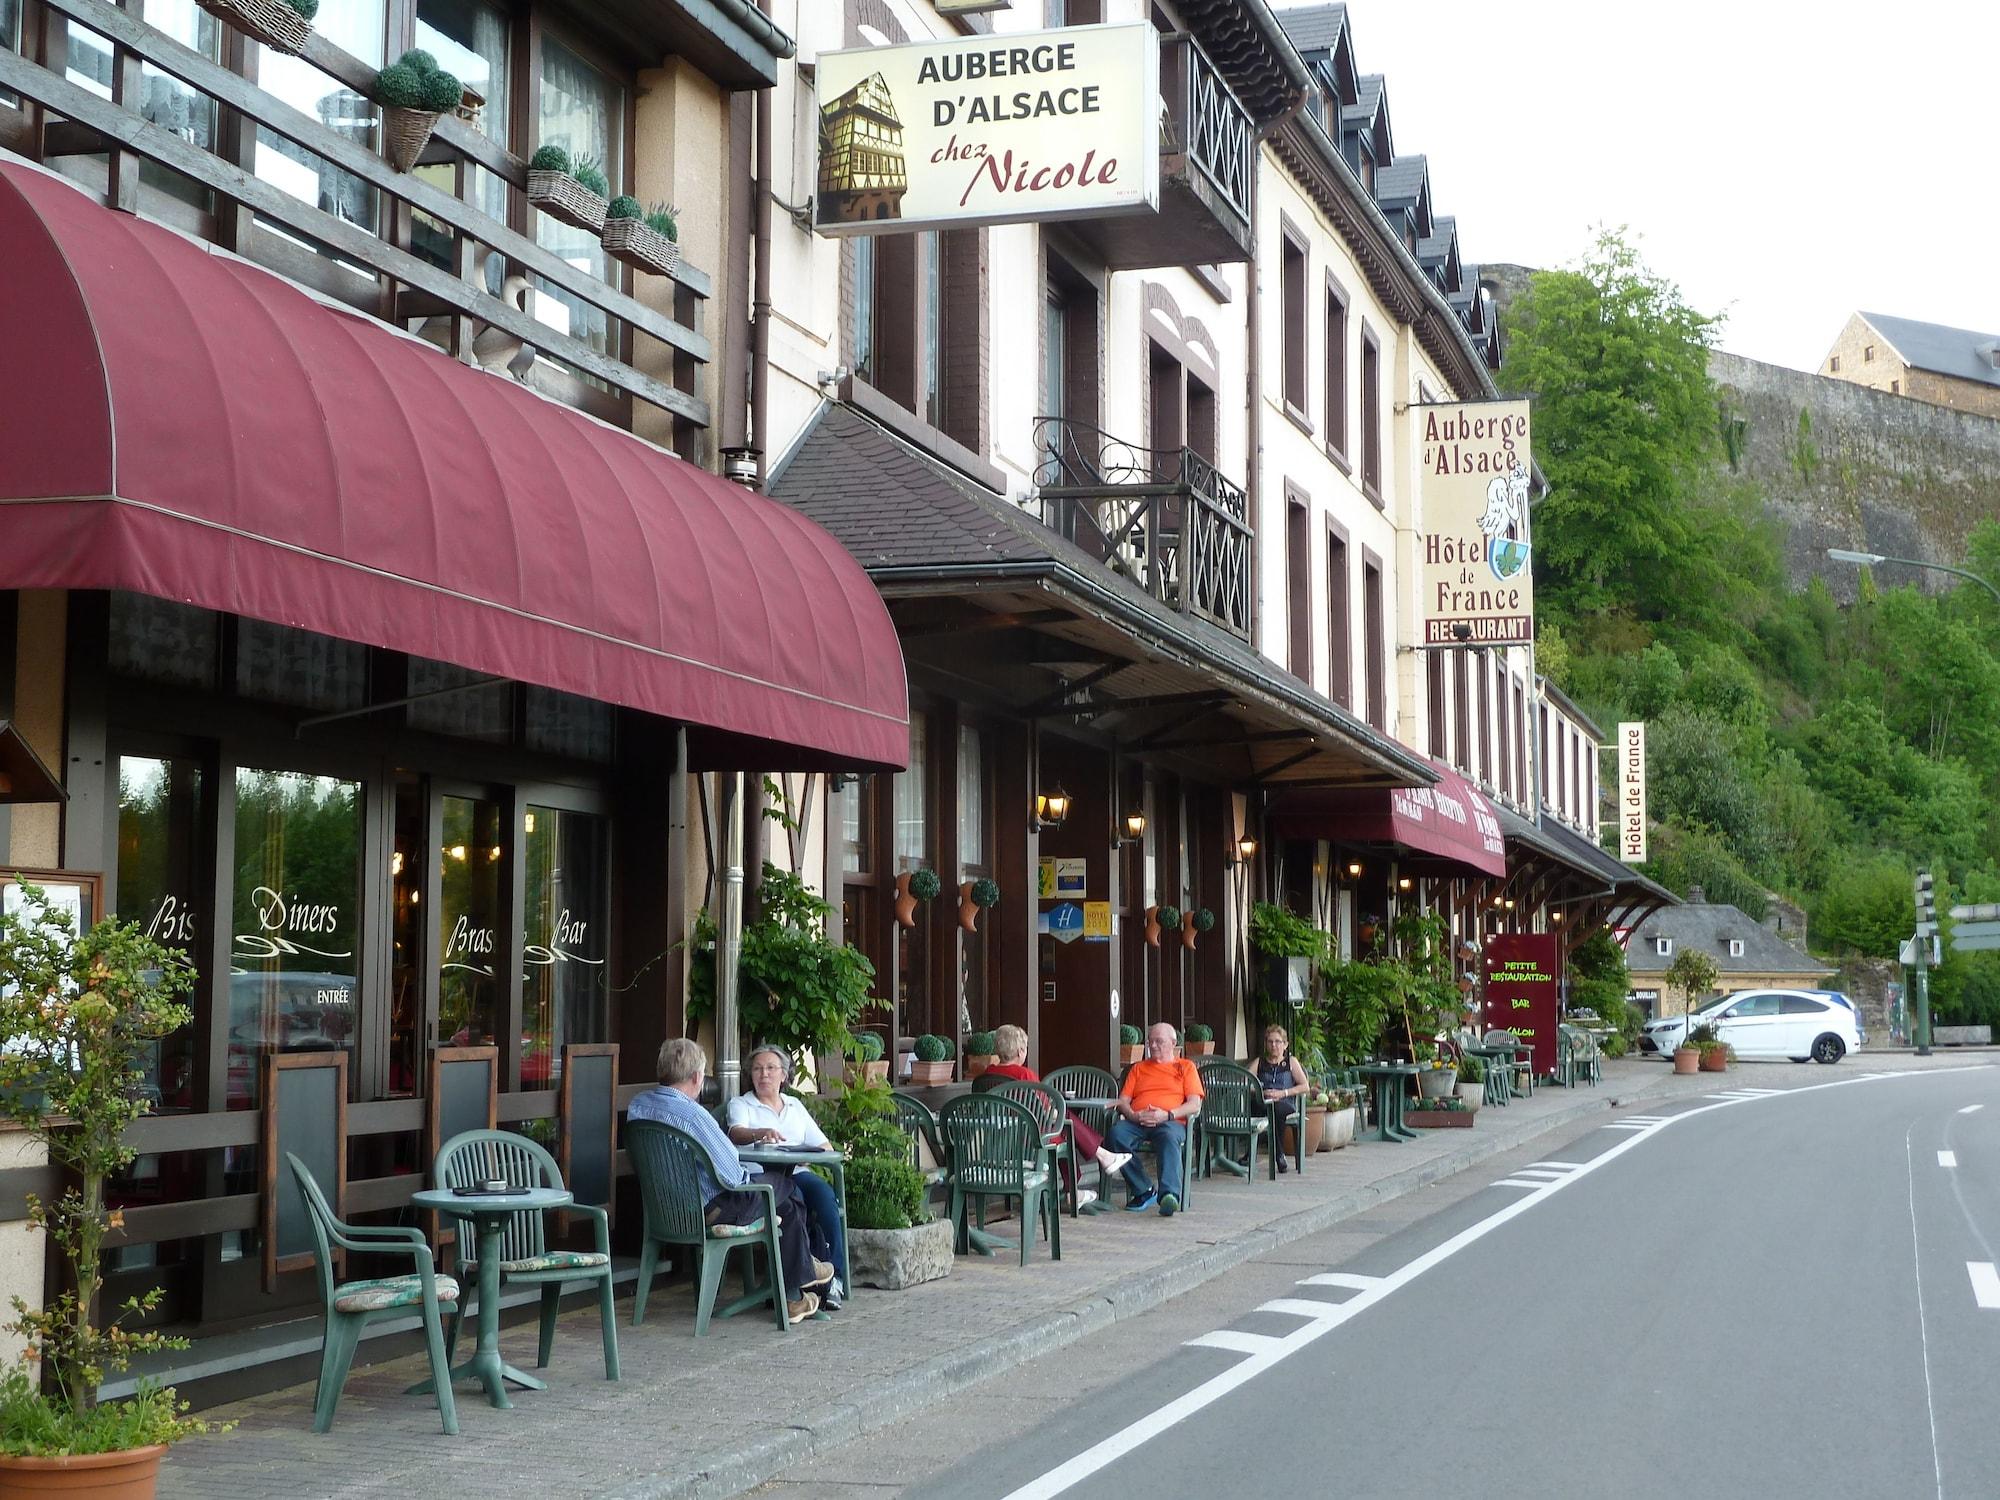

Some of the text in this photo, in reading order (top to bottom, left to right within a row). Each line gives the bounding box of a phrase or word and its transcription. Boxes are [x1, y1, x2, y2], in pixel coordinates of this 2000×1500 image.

[917, 42, 1076, 84] AUBERGE
[933, 86, 1100, 127] D'ALSACE
[930, 134, 988, 164] chez
[960, 149, 1118, 207] Nicole
[1424, 410, 1526, 450] Auberge
[1424, 444, 1517, 475] d'Alsace
[1426, 534, 1489, 564] Hôtel
[1460, 568, 1474, 584] de
[1437, 581, 1519, 612] France
[1625, 729, 1641, 855] Hôtel de France
[252, 886, 338, 933] Diners
[551, 907, 587, 949] Bar
[1490, 971, 1552, 982] RESTAURATION
[1504, 961, 1537, 970] PETITE
[317, 985, 349, 1004] ENTRÉE
[1511, 998, 1530, 1009] BAR
